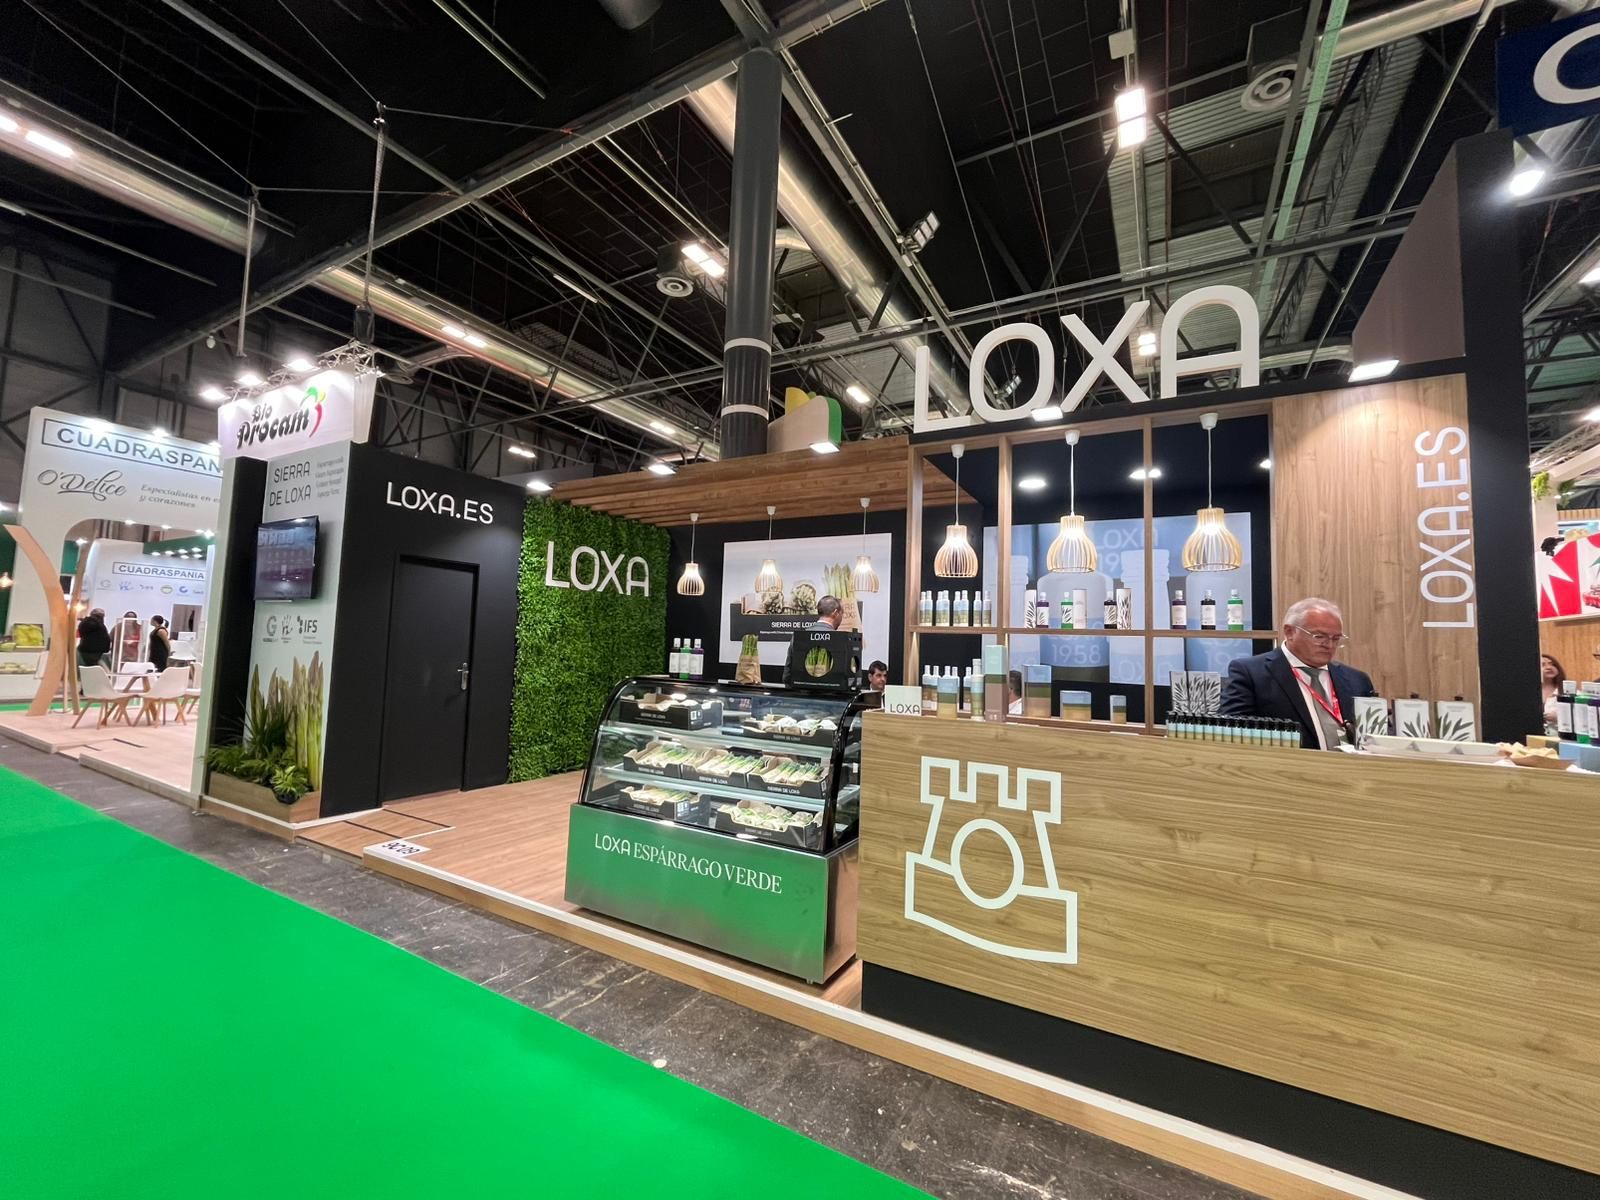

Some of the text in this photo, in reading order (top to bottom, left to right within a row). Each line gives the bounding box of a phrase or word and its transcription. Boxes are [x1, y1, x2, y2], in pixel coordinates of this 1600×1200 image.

[914, 285, 1260, 433] LOXA
[57, 427, 221, 473] CUADRASPAN
[273, 461, 310, 483] SIERRA
[269, 485, 311, 506] DE LOXA
[386, 481, 494, 525] LOXA.ES
[1415, 426, 1475, 628] LOXA.ES
[119, 564, 205, 580] CUADRASPANIA
[544, 540, 650, 597] LOXA
[304, 619, 318, 634] IFS
[771, 621, 792, 629] SIERRA
[810, 632, 831, 641] LOXA
[1052, 644, 1101, 665] 1958
[890, 703, 921, 714] LOXA
[595, 833, 782, 894] LOXA ESPÁRRAGO VERDE
